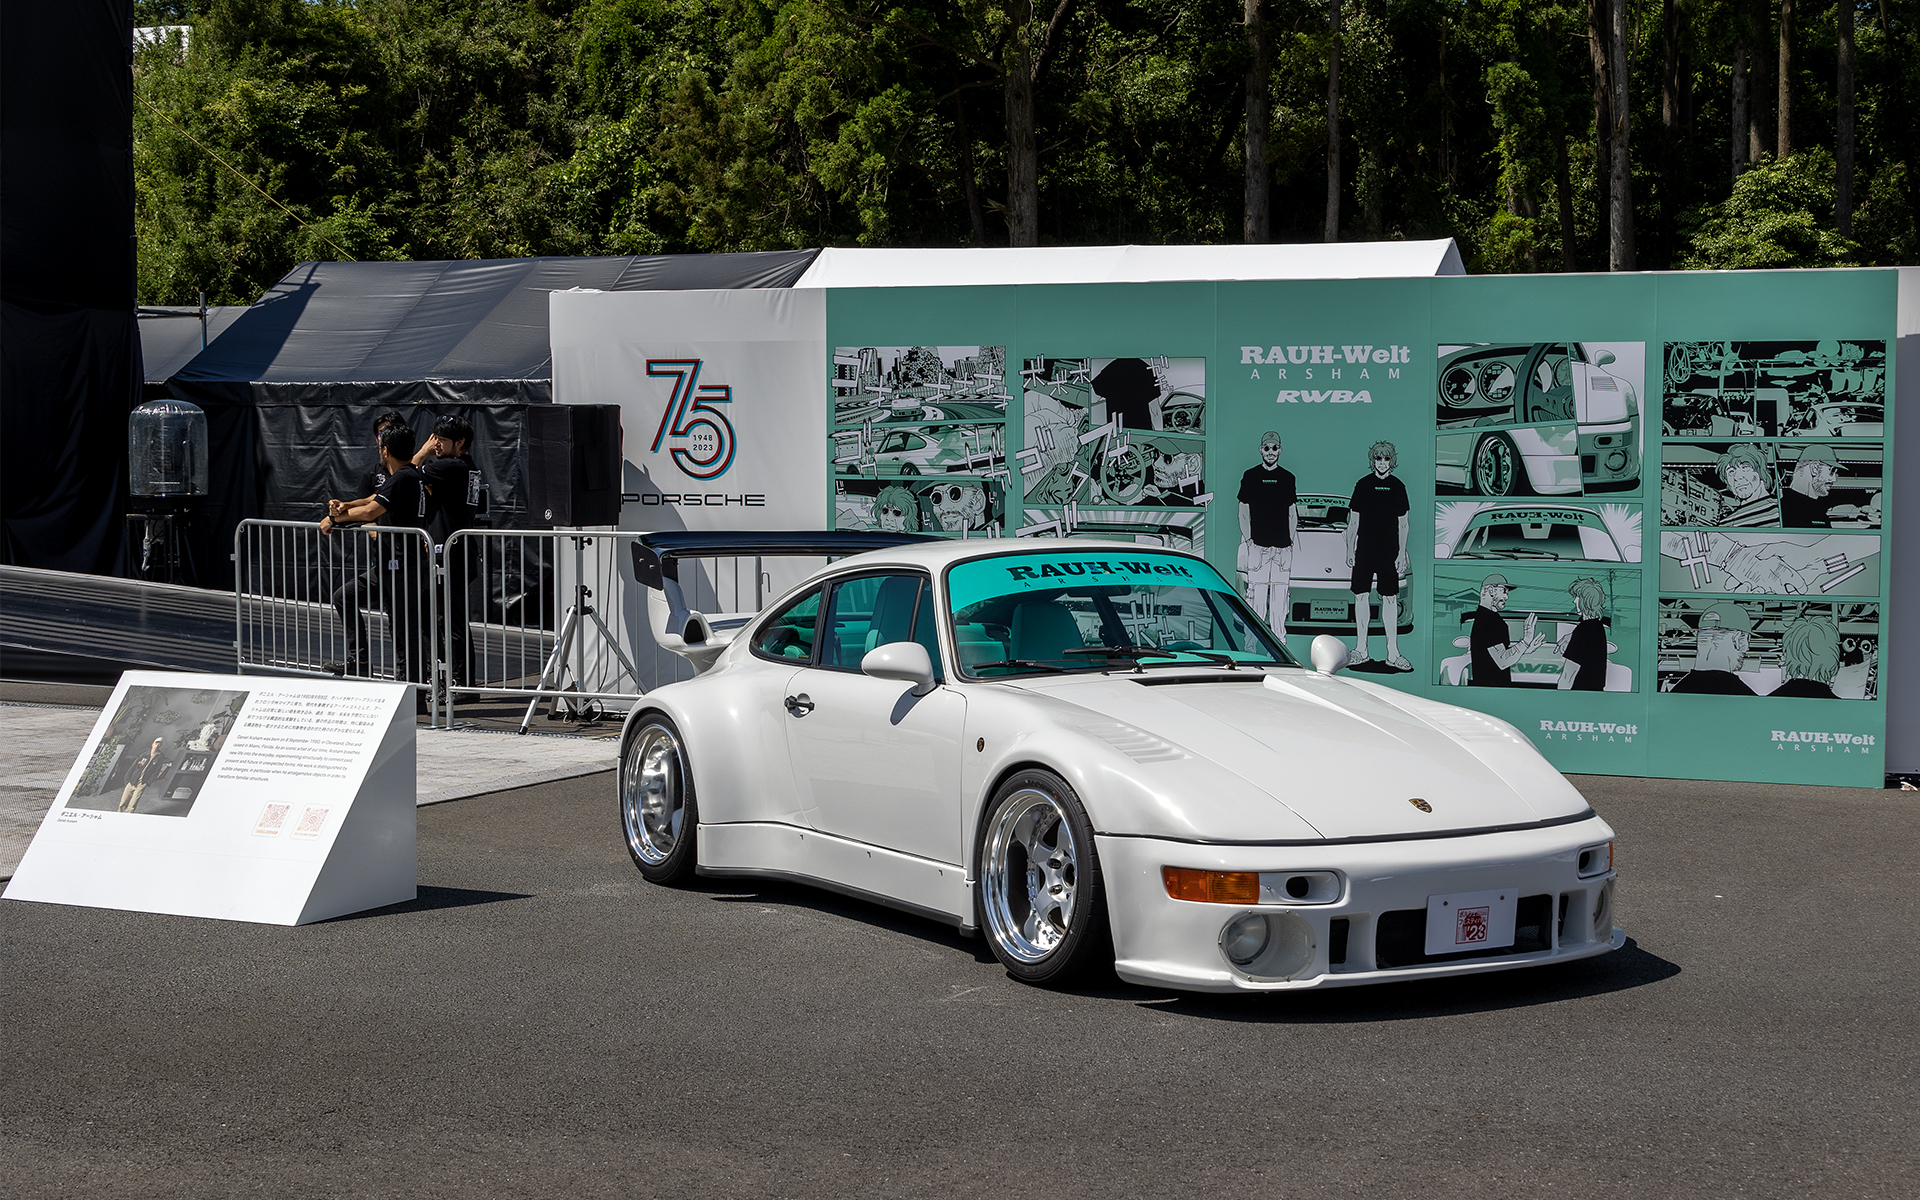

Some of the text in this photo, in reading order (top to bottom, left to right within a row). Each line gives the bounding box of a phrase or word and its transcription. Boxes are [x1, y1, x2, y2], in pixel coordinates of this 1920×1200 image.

[1240, 345, 1411, 364] RAUH-Welt
[1276, 390, 1373, 403] RWBA
[646, 359, 737, 481] 75
[693, 434, 713, 442] 1948
[622, 493, 765, 507] PORSCHE
[1006, 561, 1194, 581] RAUH-Welt
[1540, 720, 1638, 735] RAUH-Welt
[1771, 730, 1875, 745] RAUH-Welt
